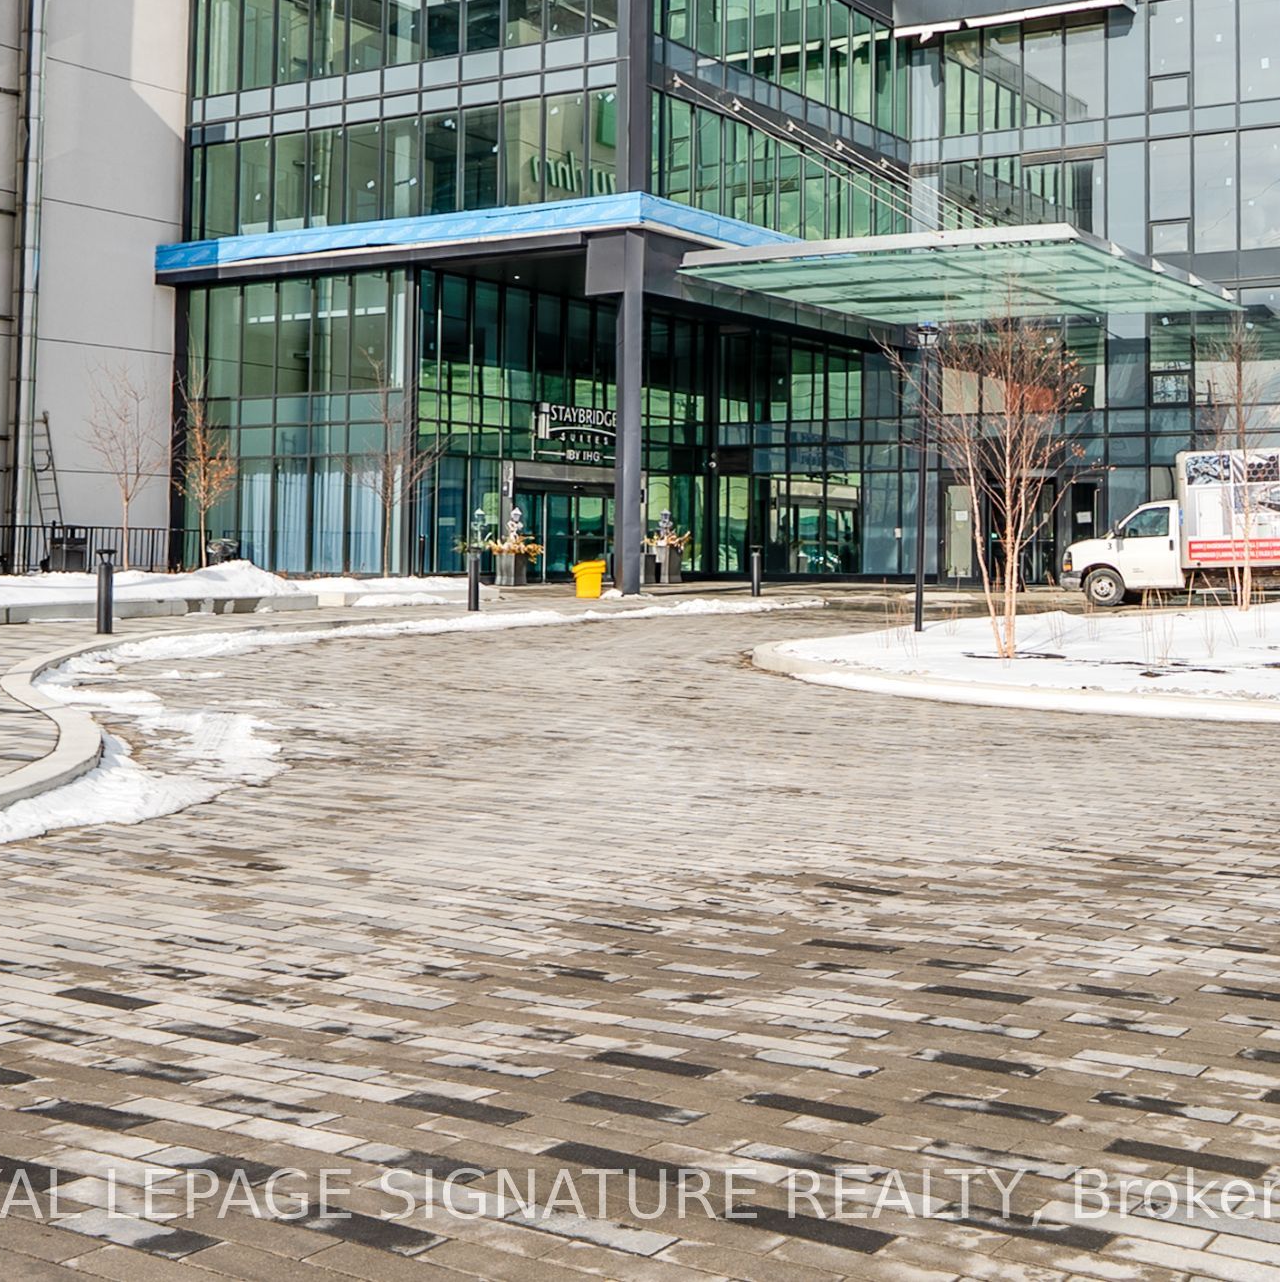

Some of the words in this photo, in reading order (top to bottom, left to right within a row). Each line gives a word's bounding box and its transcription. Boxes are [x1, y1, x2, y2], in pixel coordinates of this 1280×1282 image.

[560, 432, 609, 446] SUITES
[567, 449, 581, 461] BY
[583, 450, 600, 462] IHG
